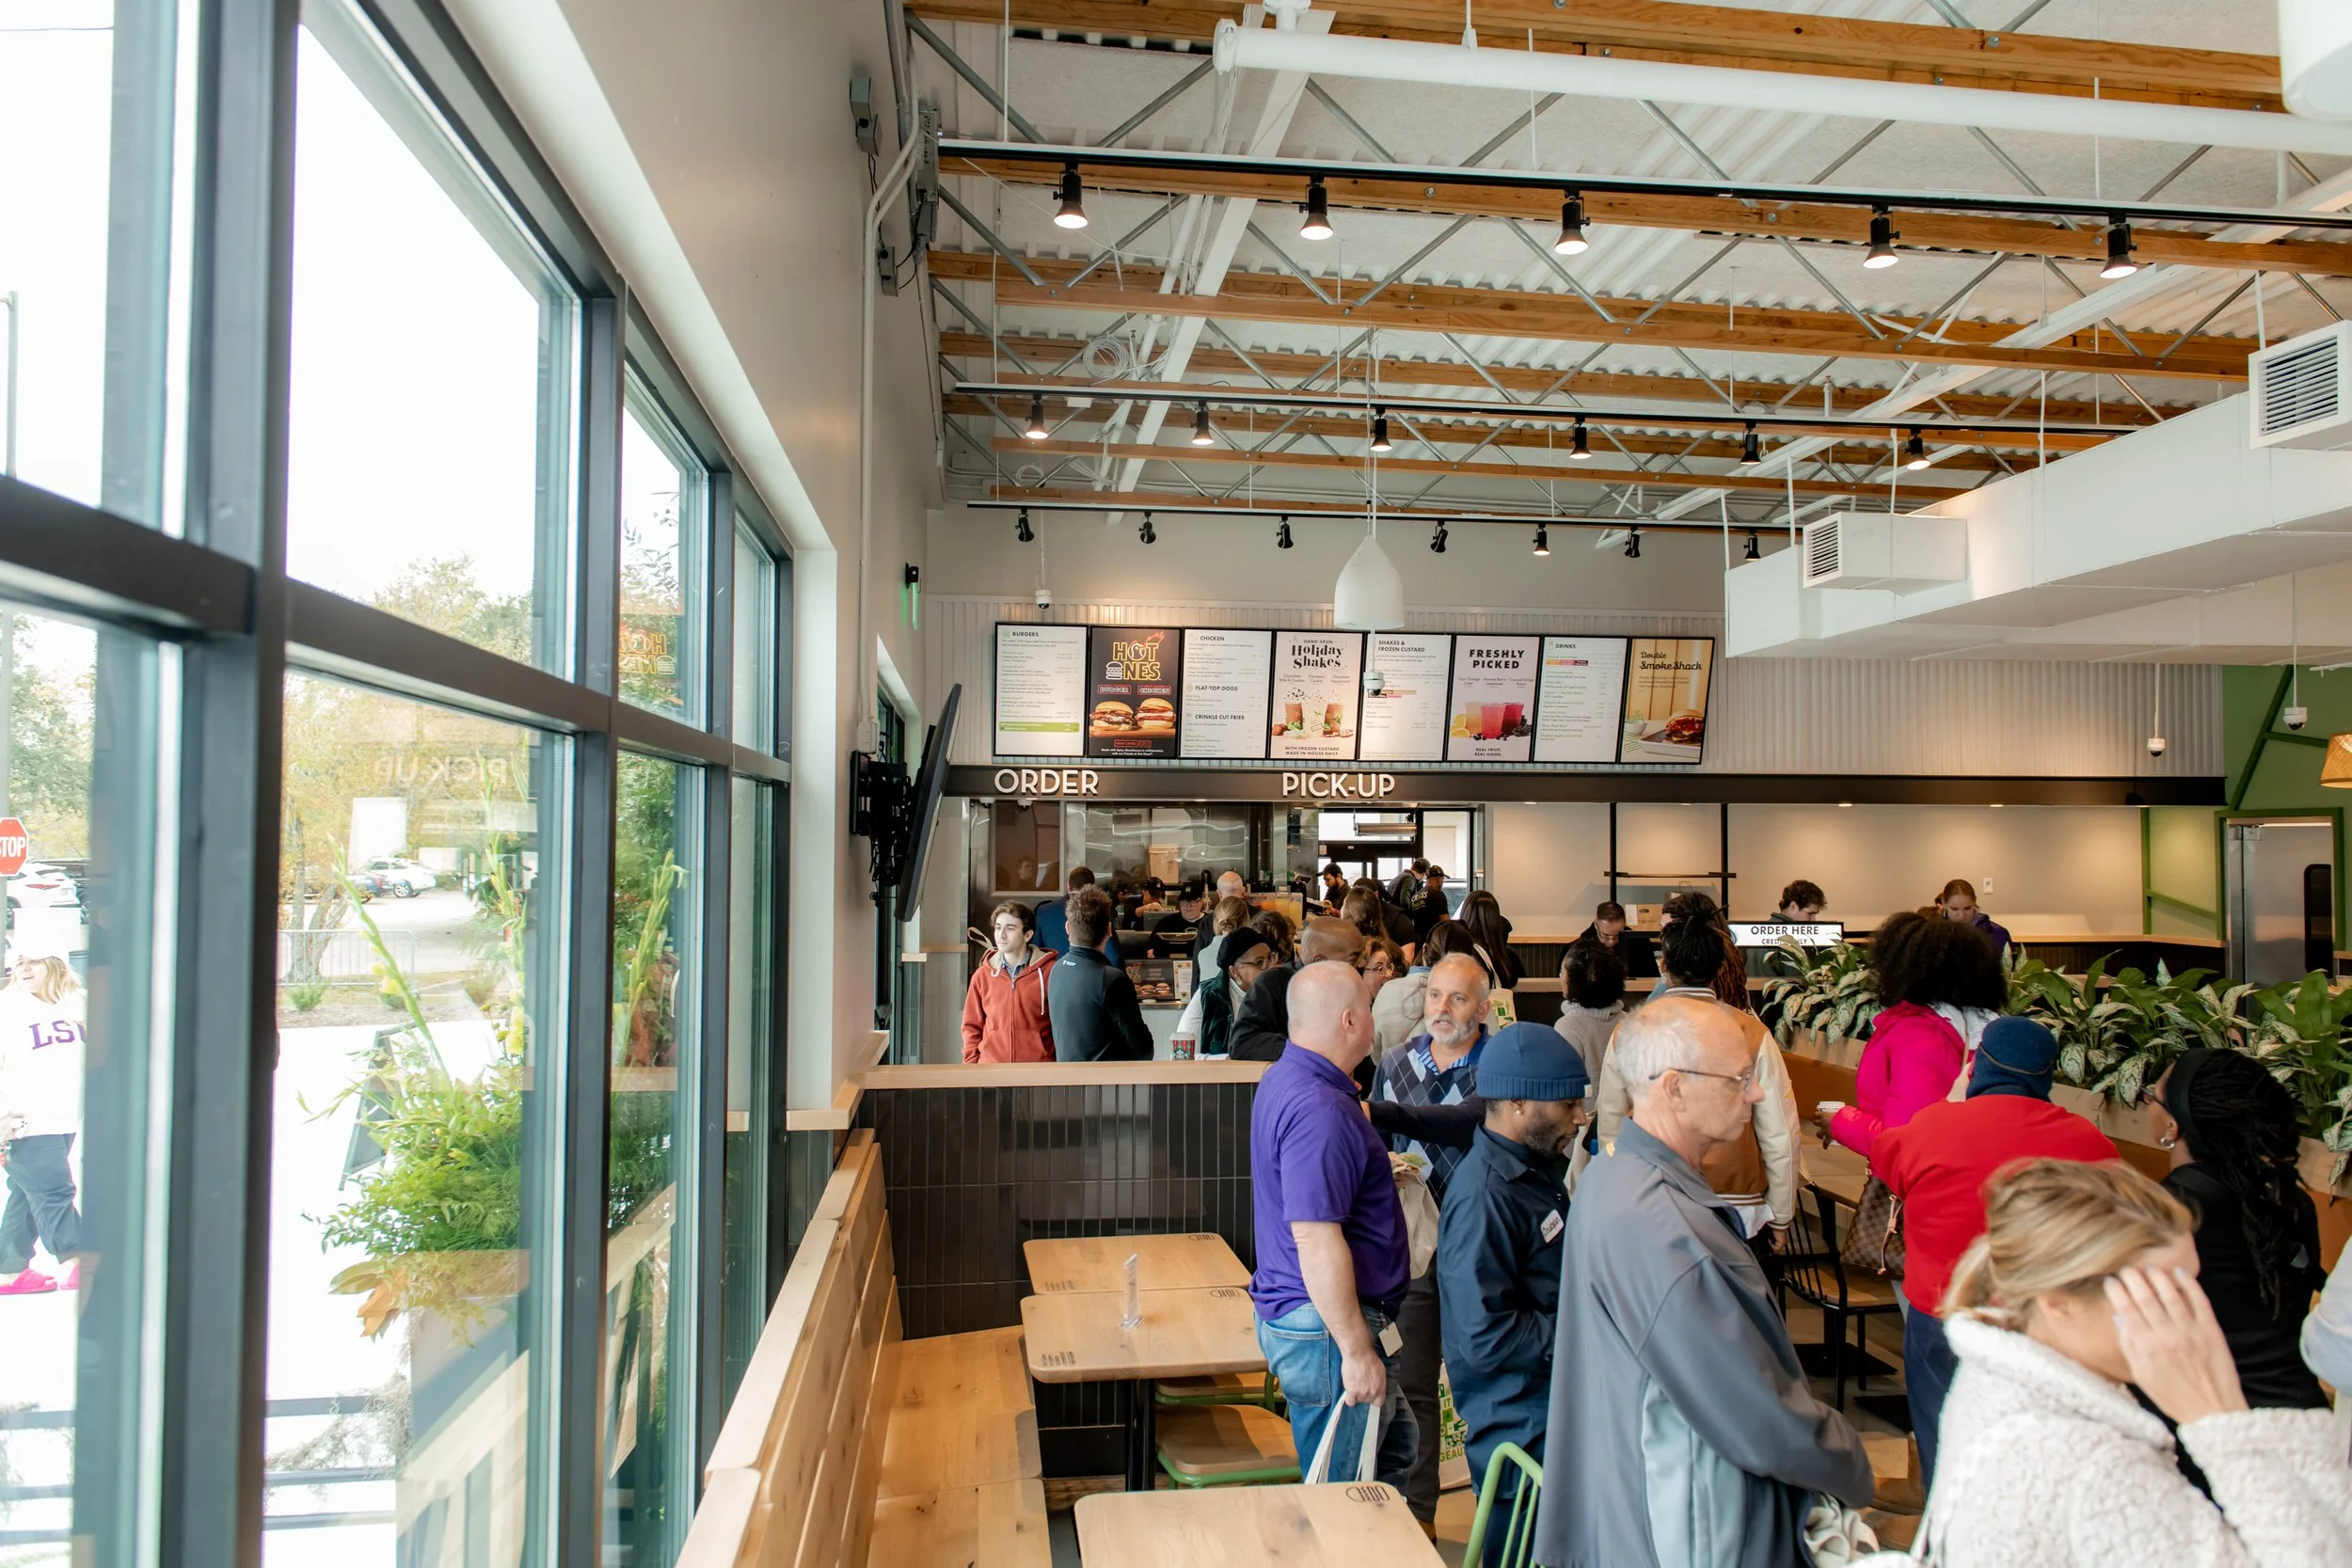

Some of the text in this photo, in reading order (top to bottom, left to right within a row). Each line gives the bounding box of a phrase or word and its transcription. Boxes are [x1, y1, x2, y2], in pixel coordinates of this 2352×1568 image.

[1112, 641, 1159, 661] HOT
[1291, 644, 1343, 658] Holiday
[1469, 649, 1525, 658] FRESHLY
[1293, 655, 1342, 669] Shakes
[1472, 659, 1519, 669] PICKED
[993, 768, 1099, 796] ORDER
[1281, 772, 1395, 798] PICK-UP
[0, 836, 26, 858] TOP
[1751, 926, 1819, 935] ORDER HERE
[1439, 1449, 1465, 1462] GEAU
